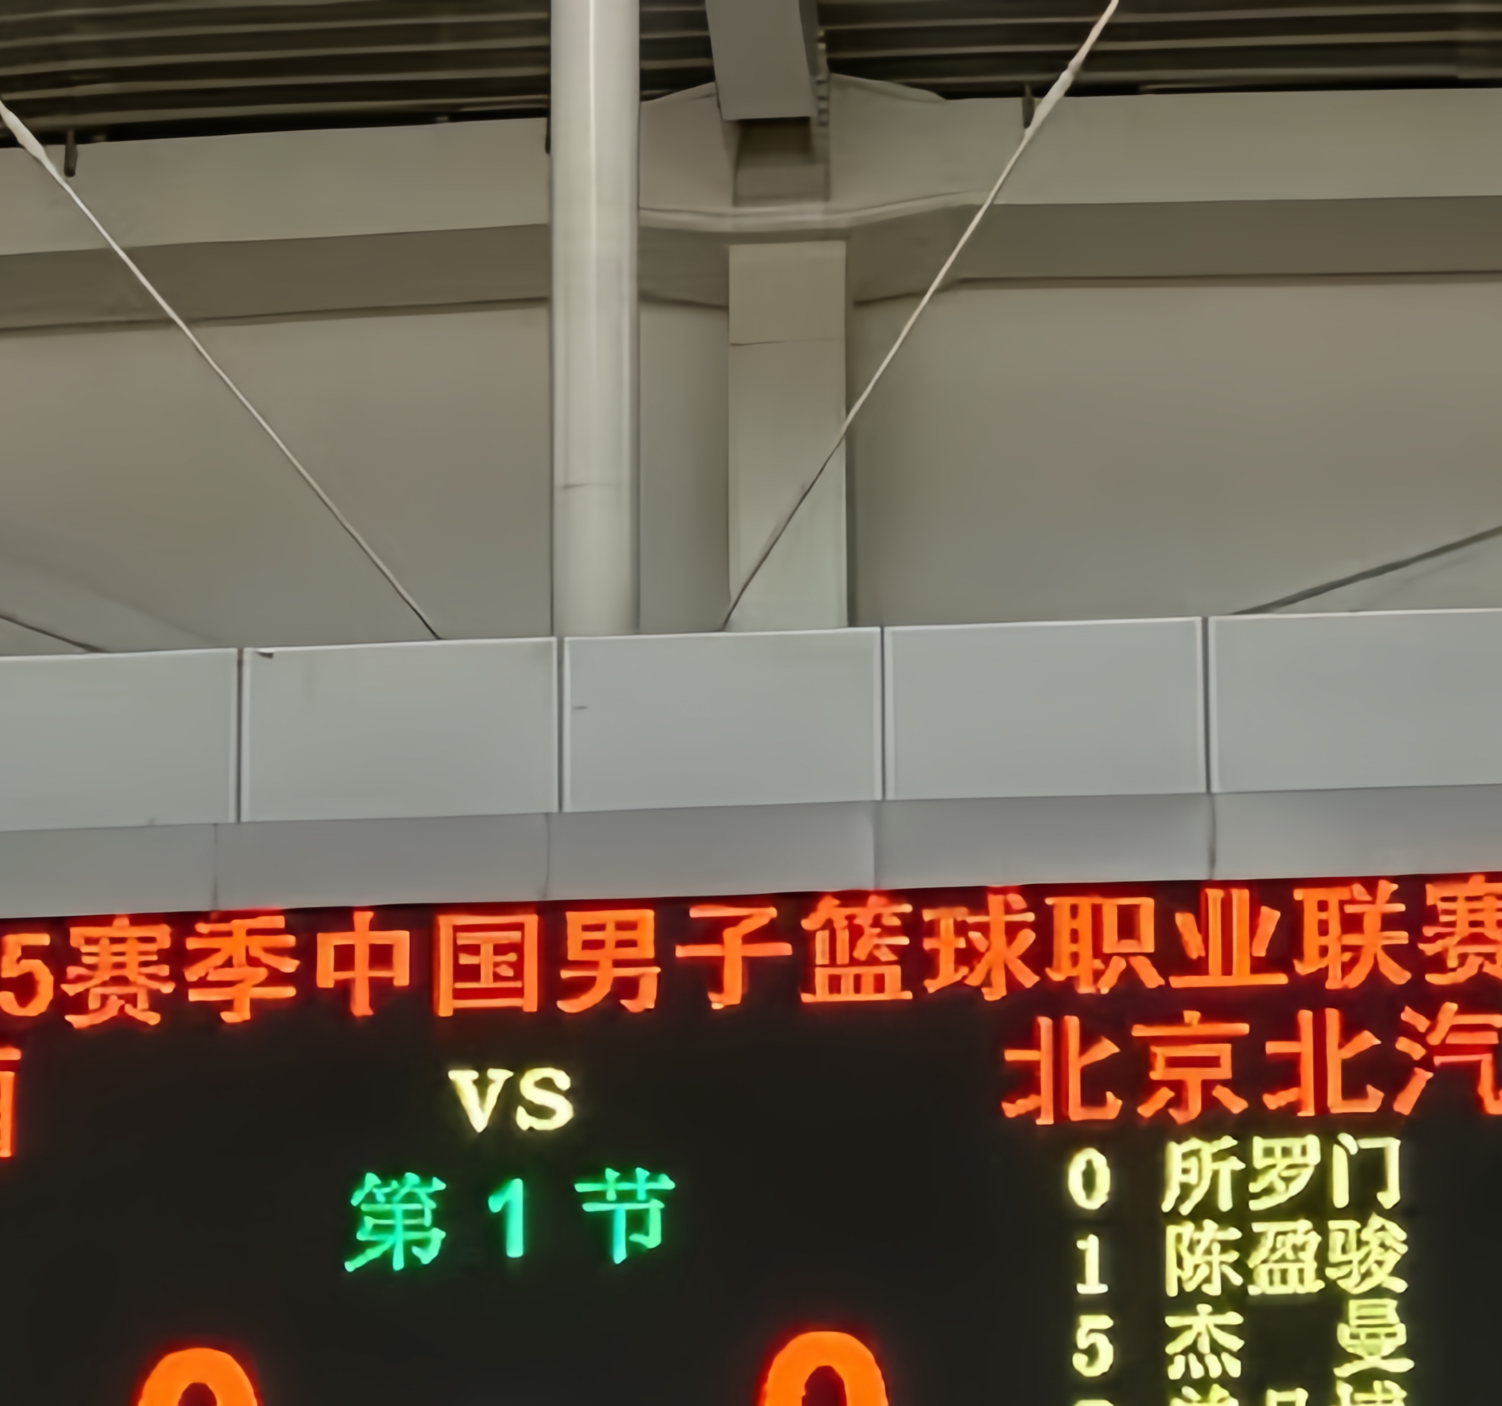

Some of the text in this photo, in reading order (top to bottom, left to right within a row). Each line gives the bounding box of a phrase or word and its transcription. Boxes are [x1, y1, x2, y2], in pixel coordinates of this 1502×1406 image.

[448, 1068, 574, 1132] VS
[1068, 1133, 1400, 1215] 0 所罗门
[1077, 1213, 1408, 1297] 1 陈盈骏
[1072, 1314, 1114, 1377] 5
